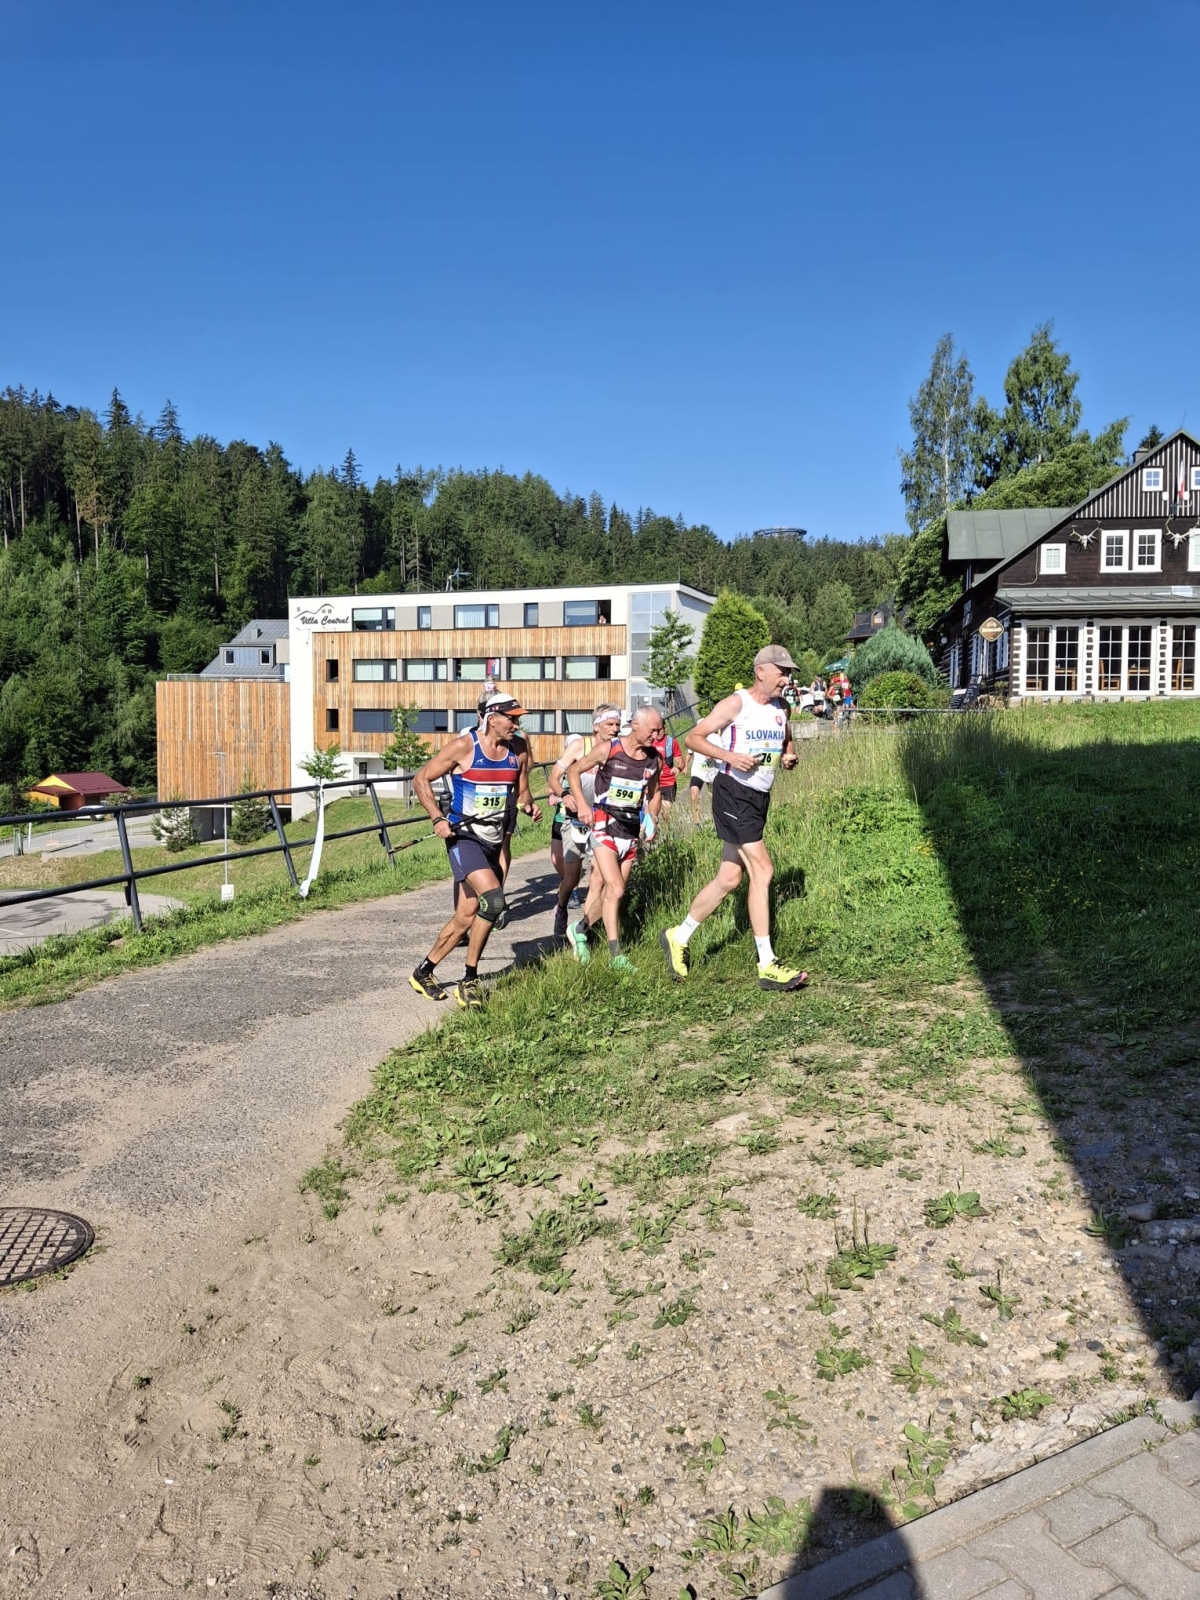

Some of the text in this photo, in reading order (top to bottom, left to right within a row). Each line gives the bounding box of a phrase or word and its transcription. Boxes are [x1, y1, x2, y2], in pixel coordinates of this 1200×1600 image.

[300, 615, 349, 625] Villa Central
[745, 730, 784, 740] SLOVAKIA
[616, 789, 634, 799] 594
[483, 797, 500, 807] 315
